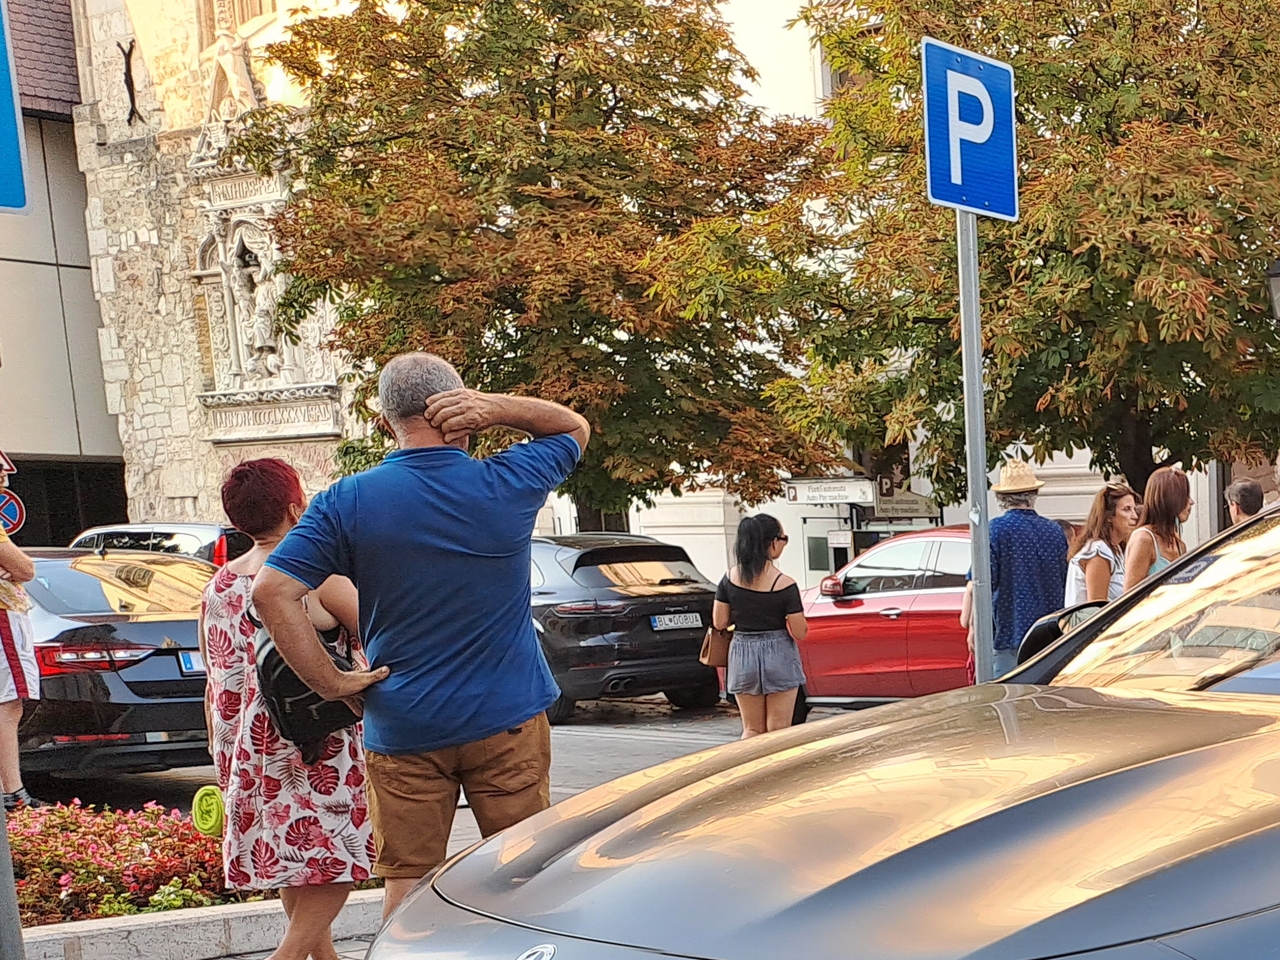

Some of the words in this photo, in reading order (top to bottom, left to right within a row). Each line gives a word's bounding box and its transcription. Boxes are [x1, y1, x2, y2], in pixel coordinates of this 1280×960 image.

[947, 69, 994, 185] P
[882, 478, 891, 493] P
[789, 487, 796, 500] P
